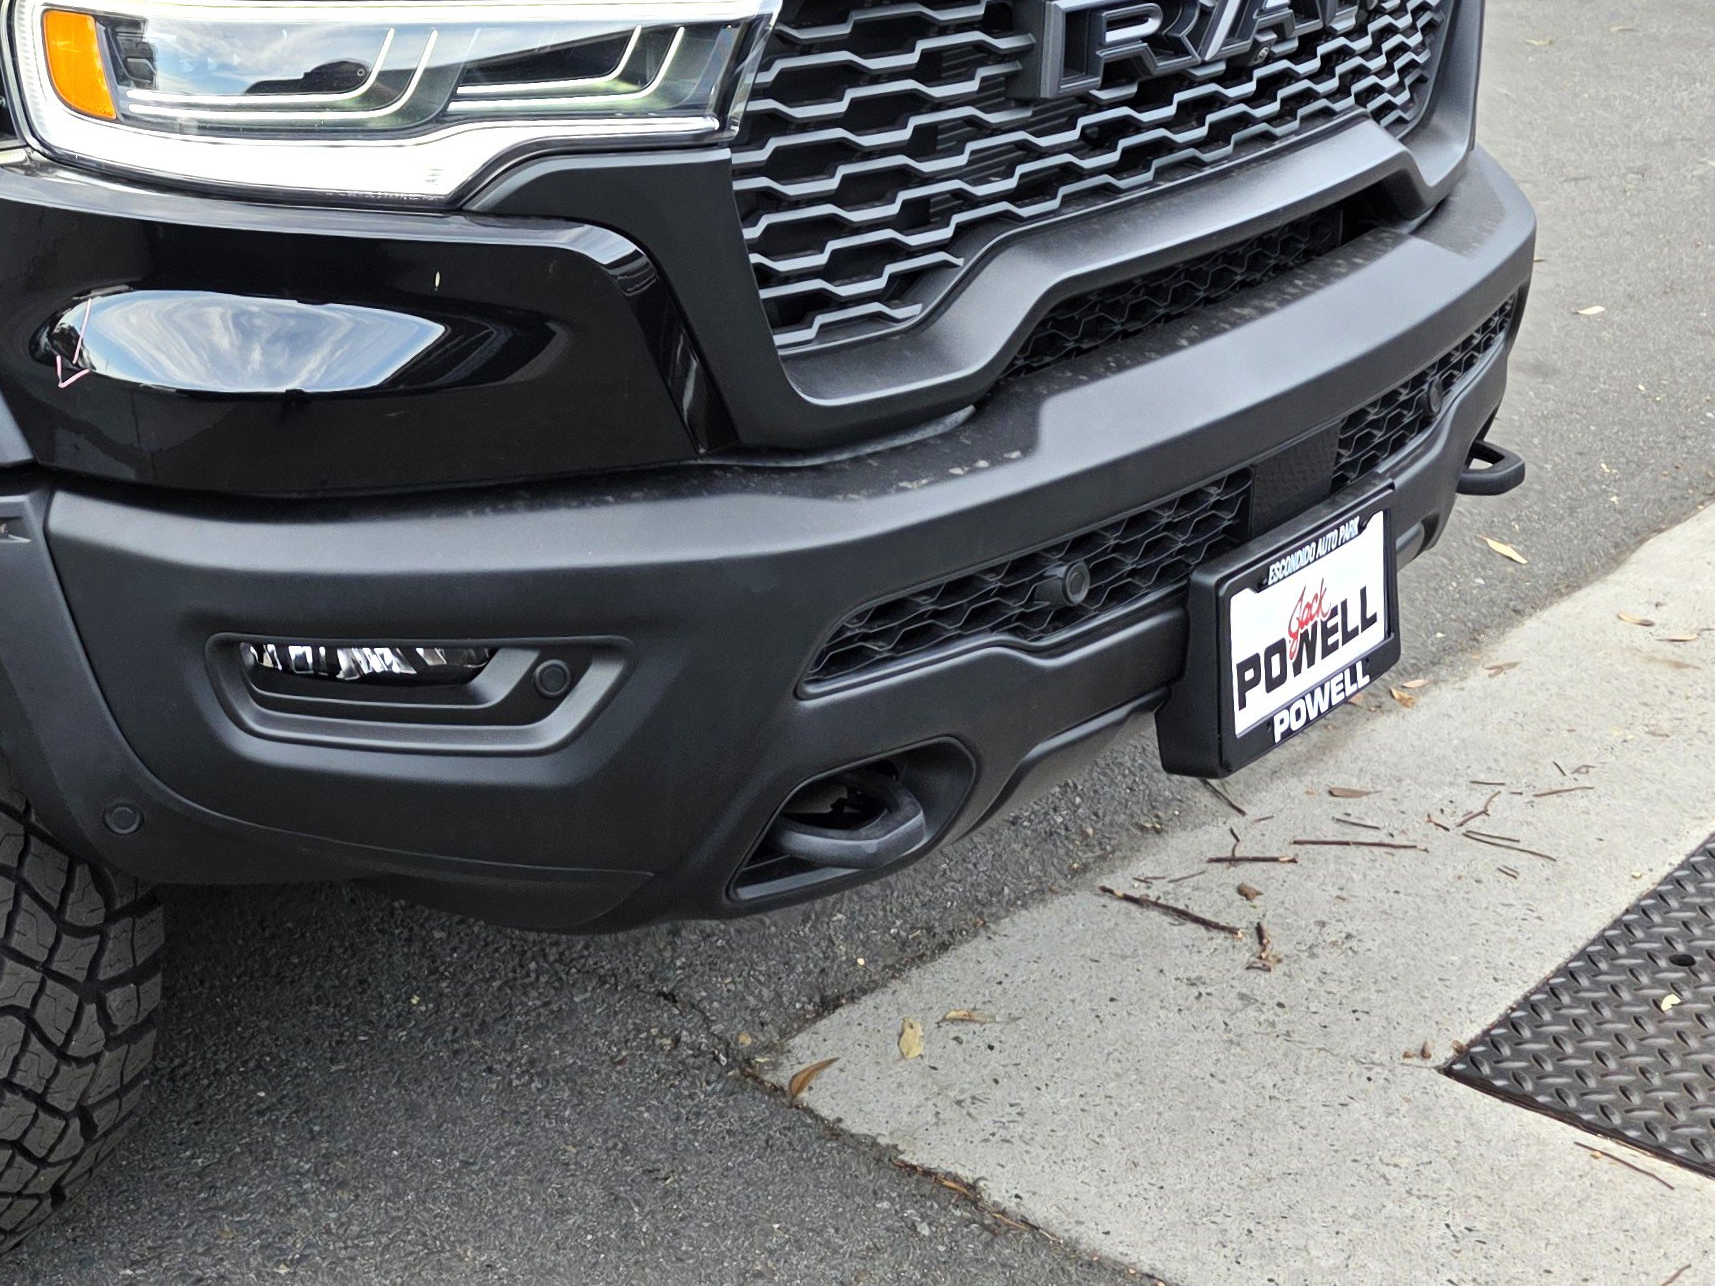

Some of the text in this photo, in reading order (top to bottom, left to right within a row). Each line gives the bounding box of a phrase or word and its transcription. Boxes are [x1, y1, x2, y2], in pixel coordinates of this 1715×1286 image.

[1268, 515, 1361, 586] ESCONDIDO AUTO PARK
[1235, 585, 1378, 712] POWELL
[1287, 577, 1332, 661] Jack
[1273, 660, 1371, 744] POWELL
